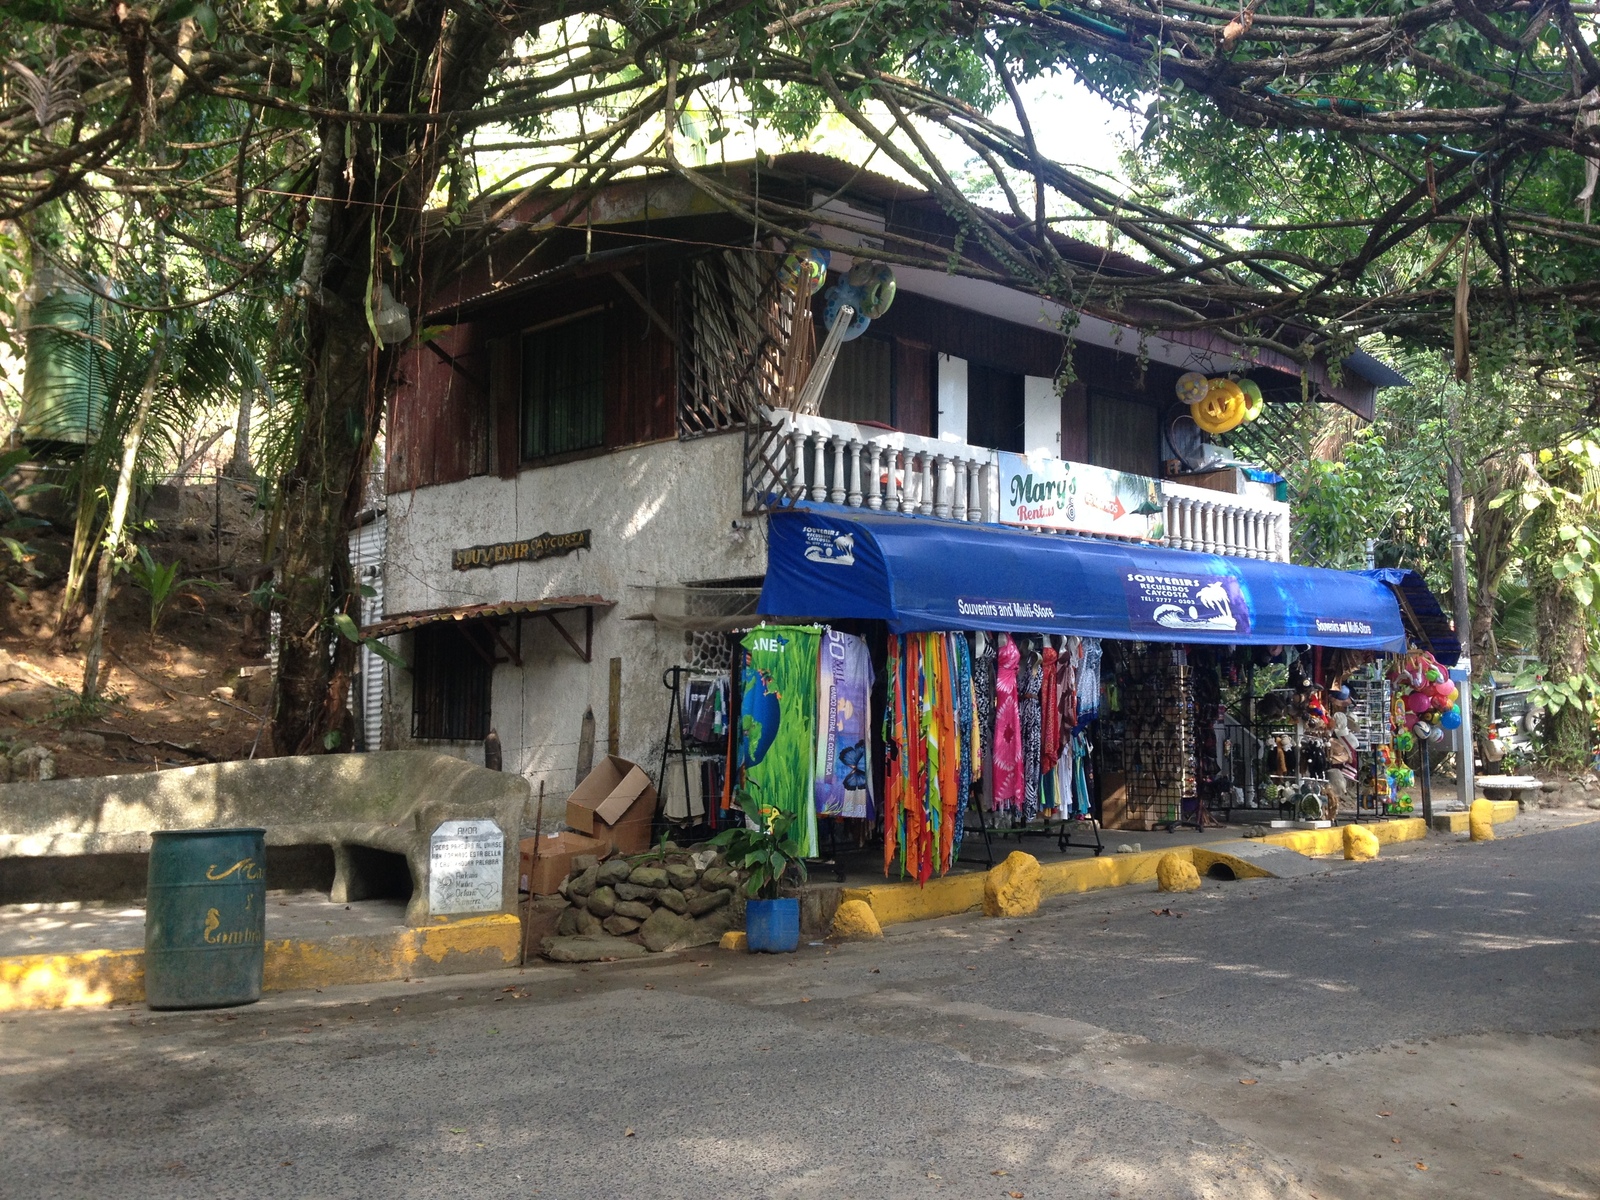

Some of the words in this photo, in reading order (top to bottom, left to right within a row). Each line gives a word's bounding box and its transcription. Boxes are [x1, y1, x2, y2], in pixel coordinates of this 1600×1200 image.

[1010, 463, 1077, 510] Mary's
[456, 543, 530, 566] SOUVENIR
[1127, 573, 1200, 587] SOUVENIRS
[1140, 583, 1190, 593] RECUERDOS
[1145, 589, 1189, 598] CAYCOSTA
[957, 599, 998, 617] Souvenirs
[998, 602, 1014, 617] and
[1013, 602, 1055, 618] Multi-Store
[1315, 619, 1339, 631] Souvenirs
[1339, 621, 1348, 633] and
[829, 708, 837, 732] CENTRAL
[828, 733, 835, 741] DE
[825, 762, 833, 776] RICA
[457, 827, 478, 835] AMOR
[470, 850, 483, 858] ESTA
